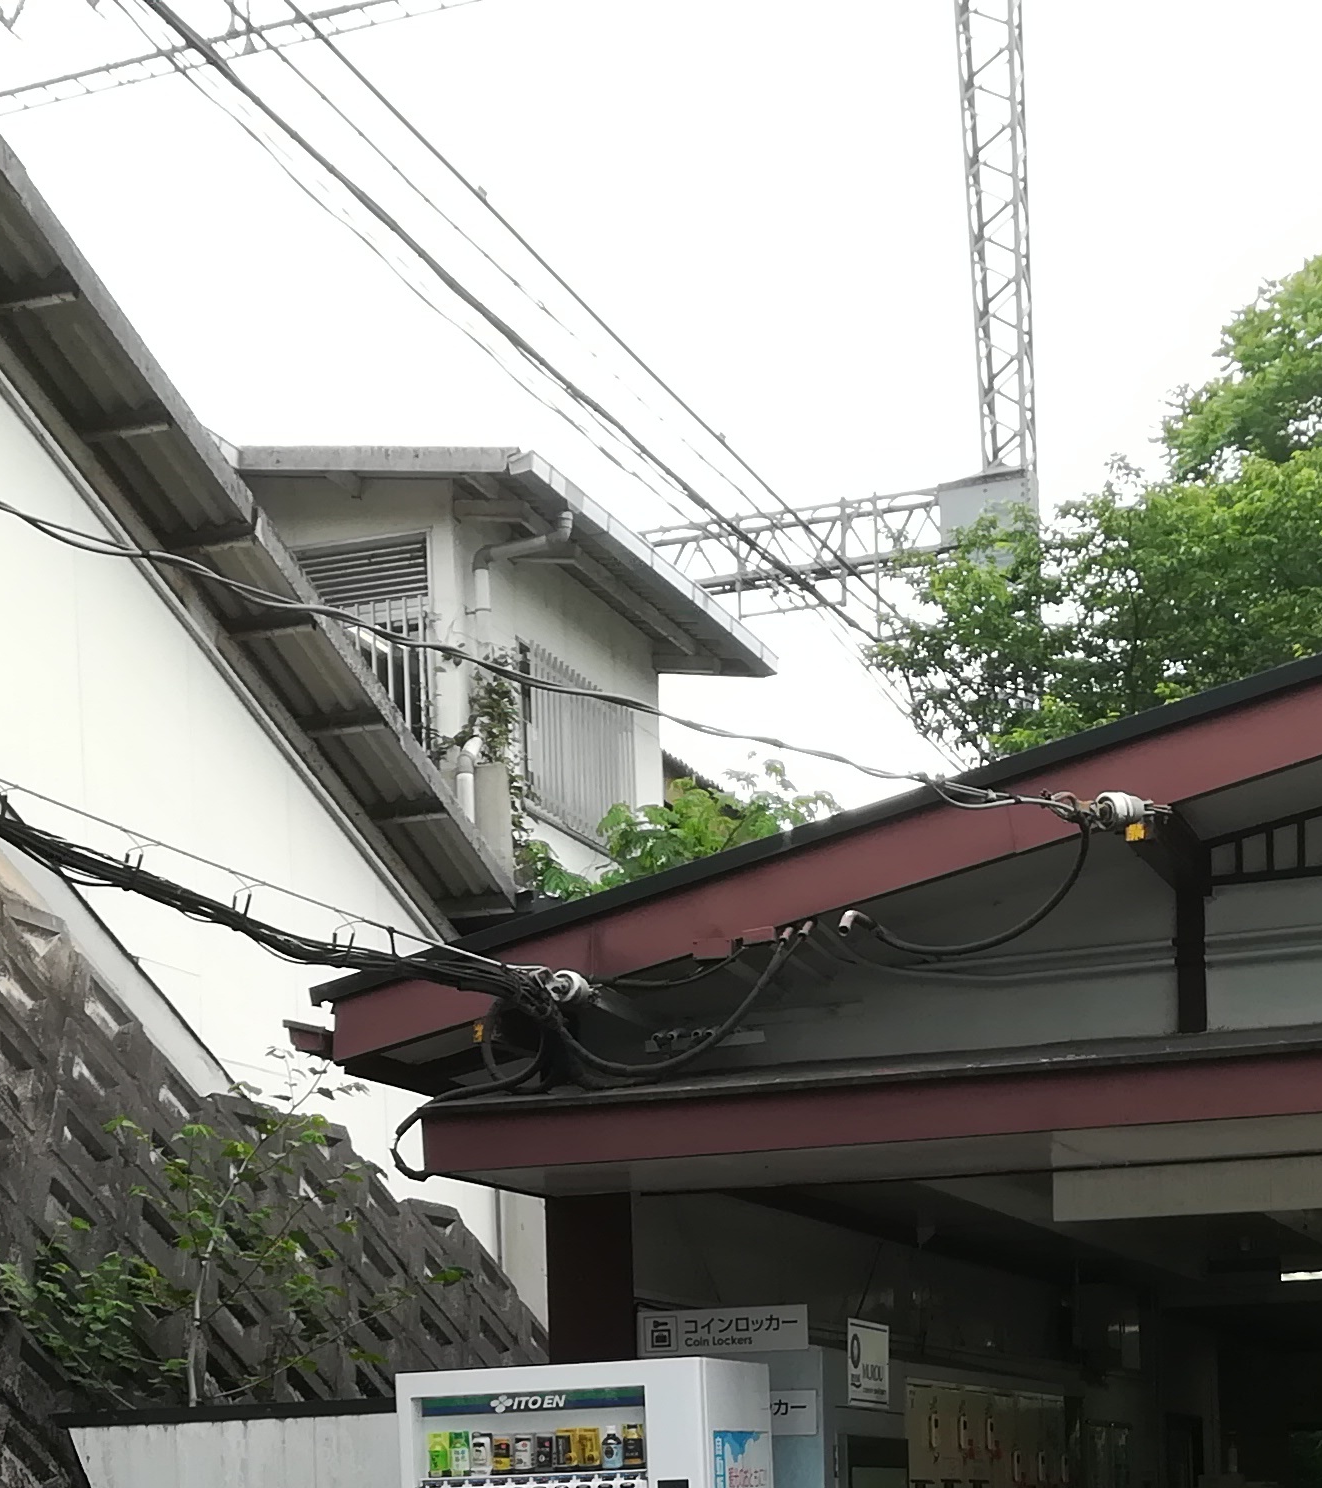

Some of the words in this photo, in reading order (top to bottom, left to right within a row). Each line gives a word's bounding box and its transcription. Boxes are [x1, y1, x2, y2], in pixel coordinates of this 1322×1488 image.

[684, 1314, 798, 1335] コインロッカー
[685, 1335, 710, 1348] Coin
[712, 1335, 753, 1347] Lockers
[512, 1396, 541, 1410] ITO
[543, 1394, 566, 1409] EN
[770, 1398, 807, 1417] カー
